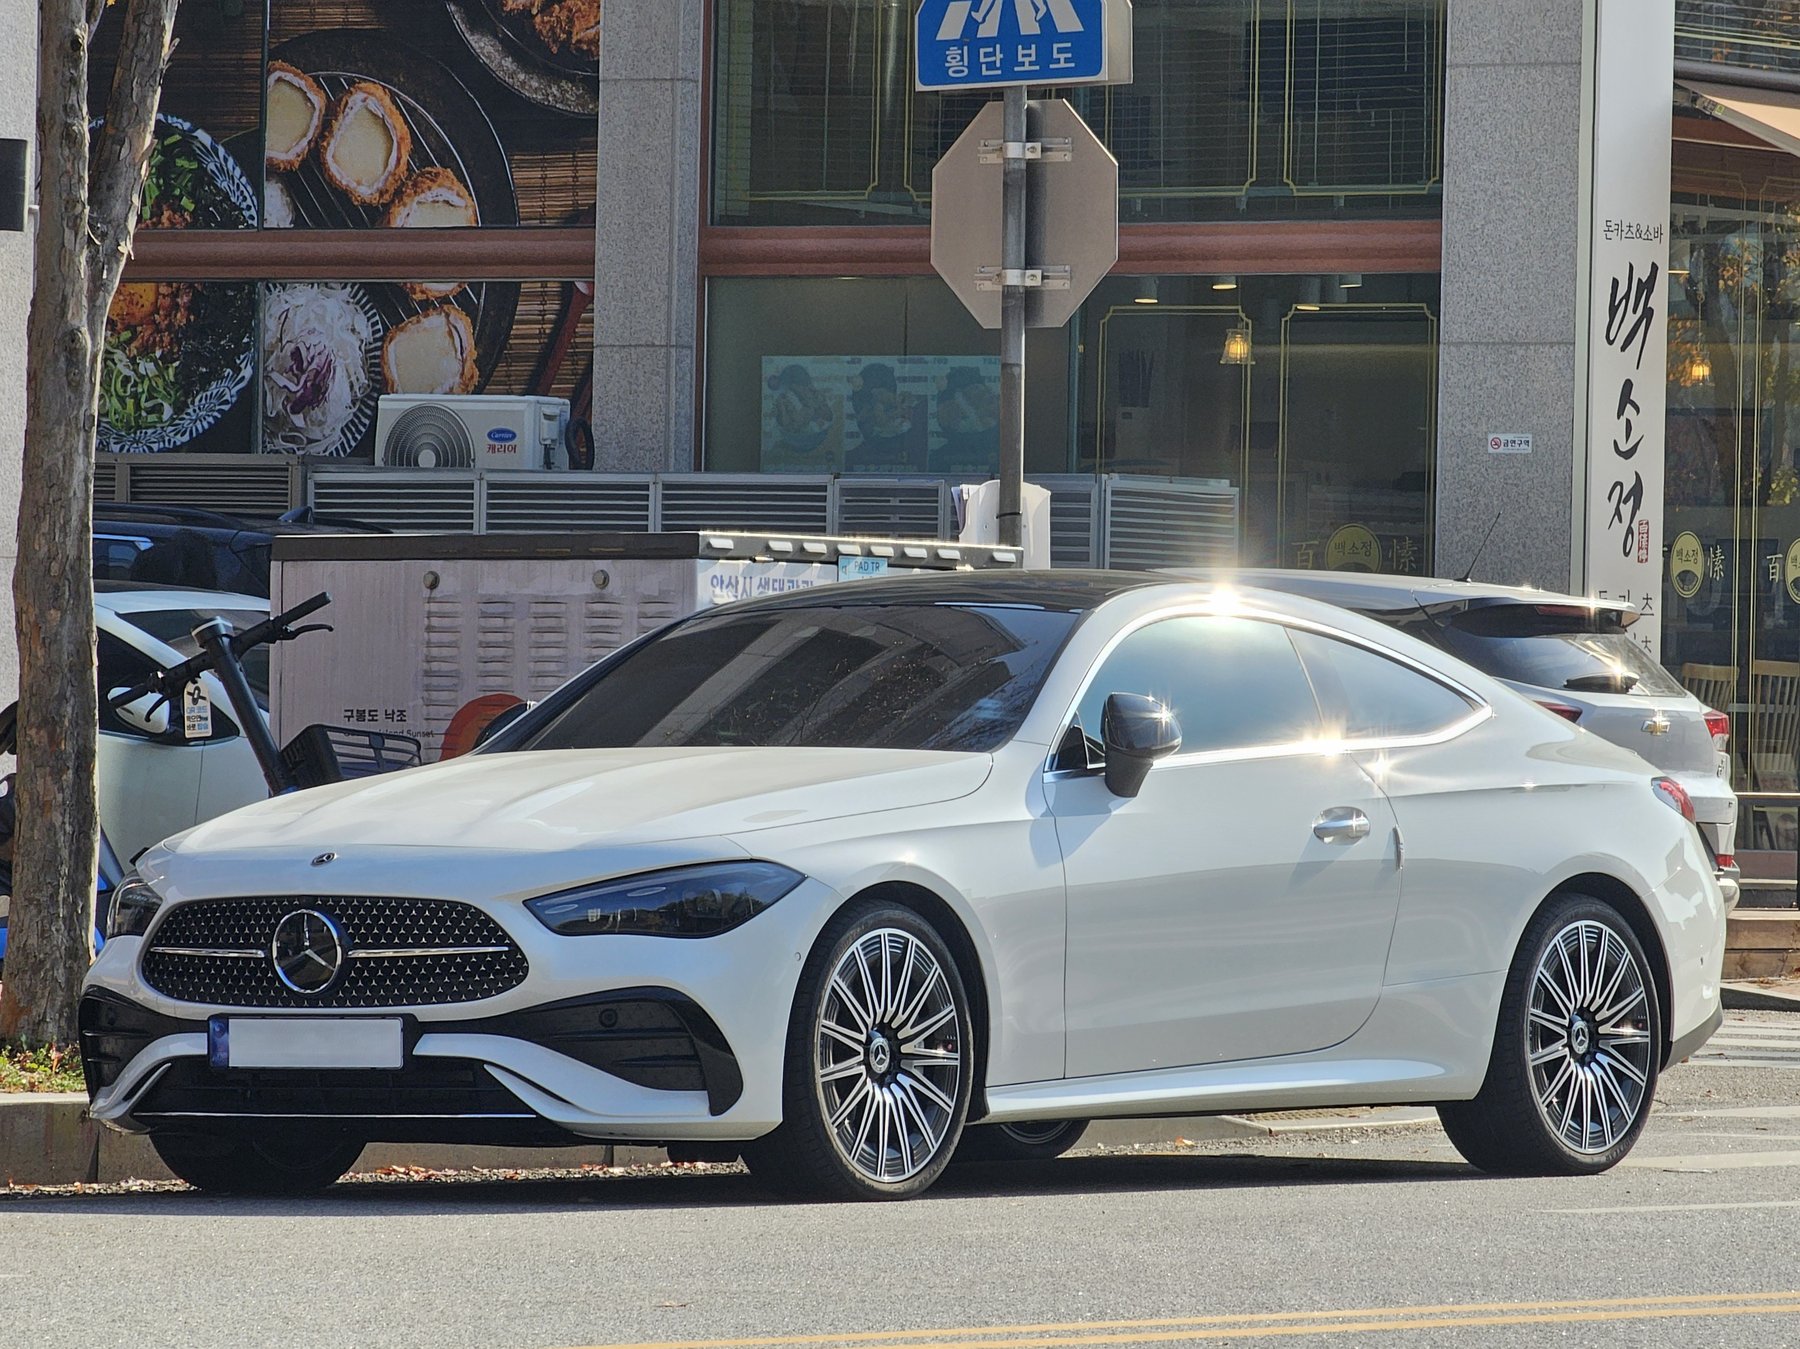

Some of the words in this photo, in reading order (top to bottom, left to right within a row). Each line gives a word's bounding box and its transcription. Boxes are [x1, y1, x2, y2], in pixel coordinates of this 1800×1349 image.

[945, 42, 1076, 78] 횡단보도
[1603, 219, 1664, 245] 돈카츠&소바
[1605, 261, 1659, 558] 백소정
[486, 443, 517, 454] 캐리어
[1503, 439, 1530, 448] 금연구역
[1334, 540, 1373, 557] 백소정
[1675, 547, 1699, 565] 백소정
[854, 560, 869, 572] PAD
[870, 561, 880, 572] TR
[384, 708, 407, 722] 낙조
